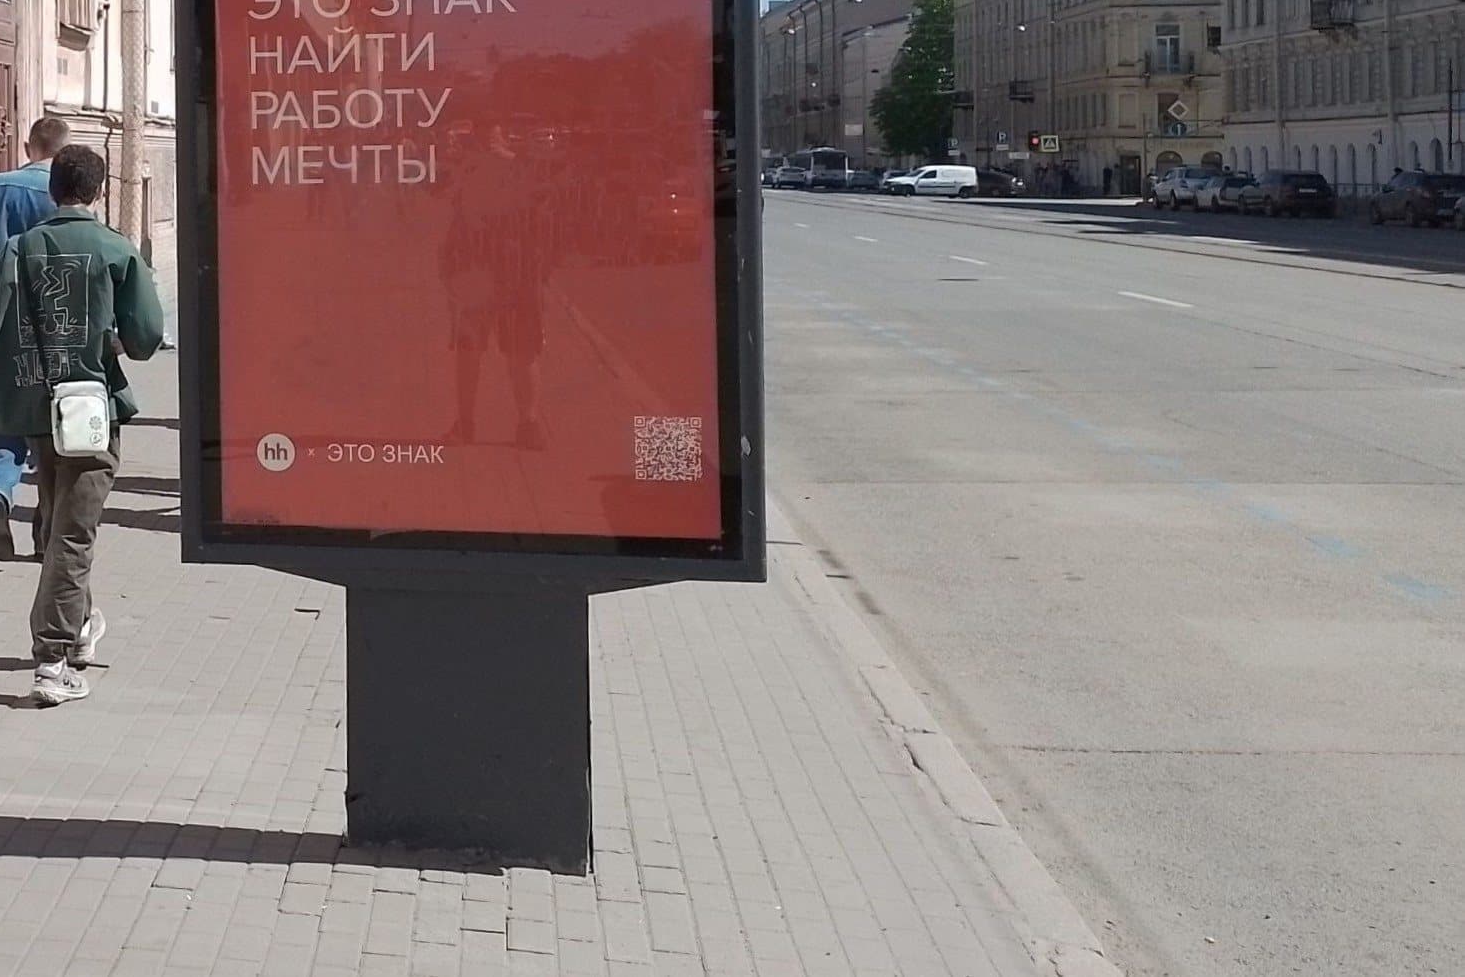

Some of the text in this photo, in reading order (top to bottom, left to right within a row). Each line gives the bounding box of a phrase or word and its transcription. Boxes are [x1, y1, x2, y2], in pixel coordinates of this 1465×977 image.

[249, 26, 435, 74] НАЙТИ
[250, 87, 453, 129] РАБОТУ
[252, 144, 436, 185] МЕЧТЫ
[264, 443, 288, 461] hh
[326, 443, 444, 464] ЭТО ЗНАК
